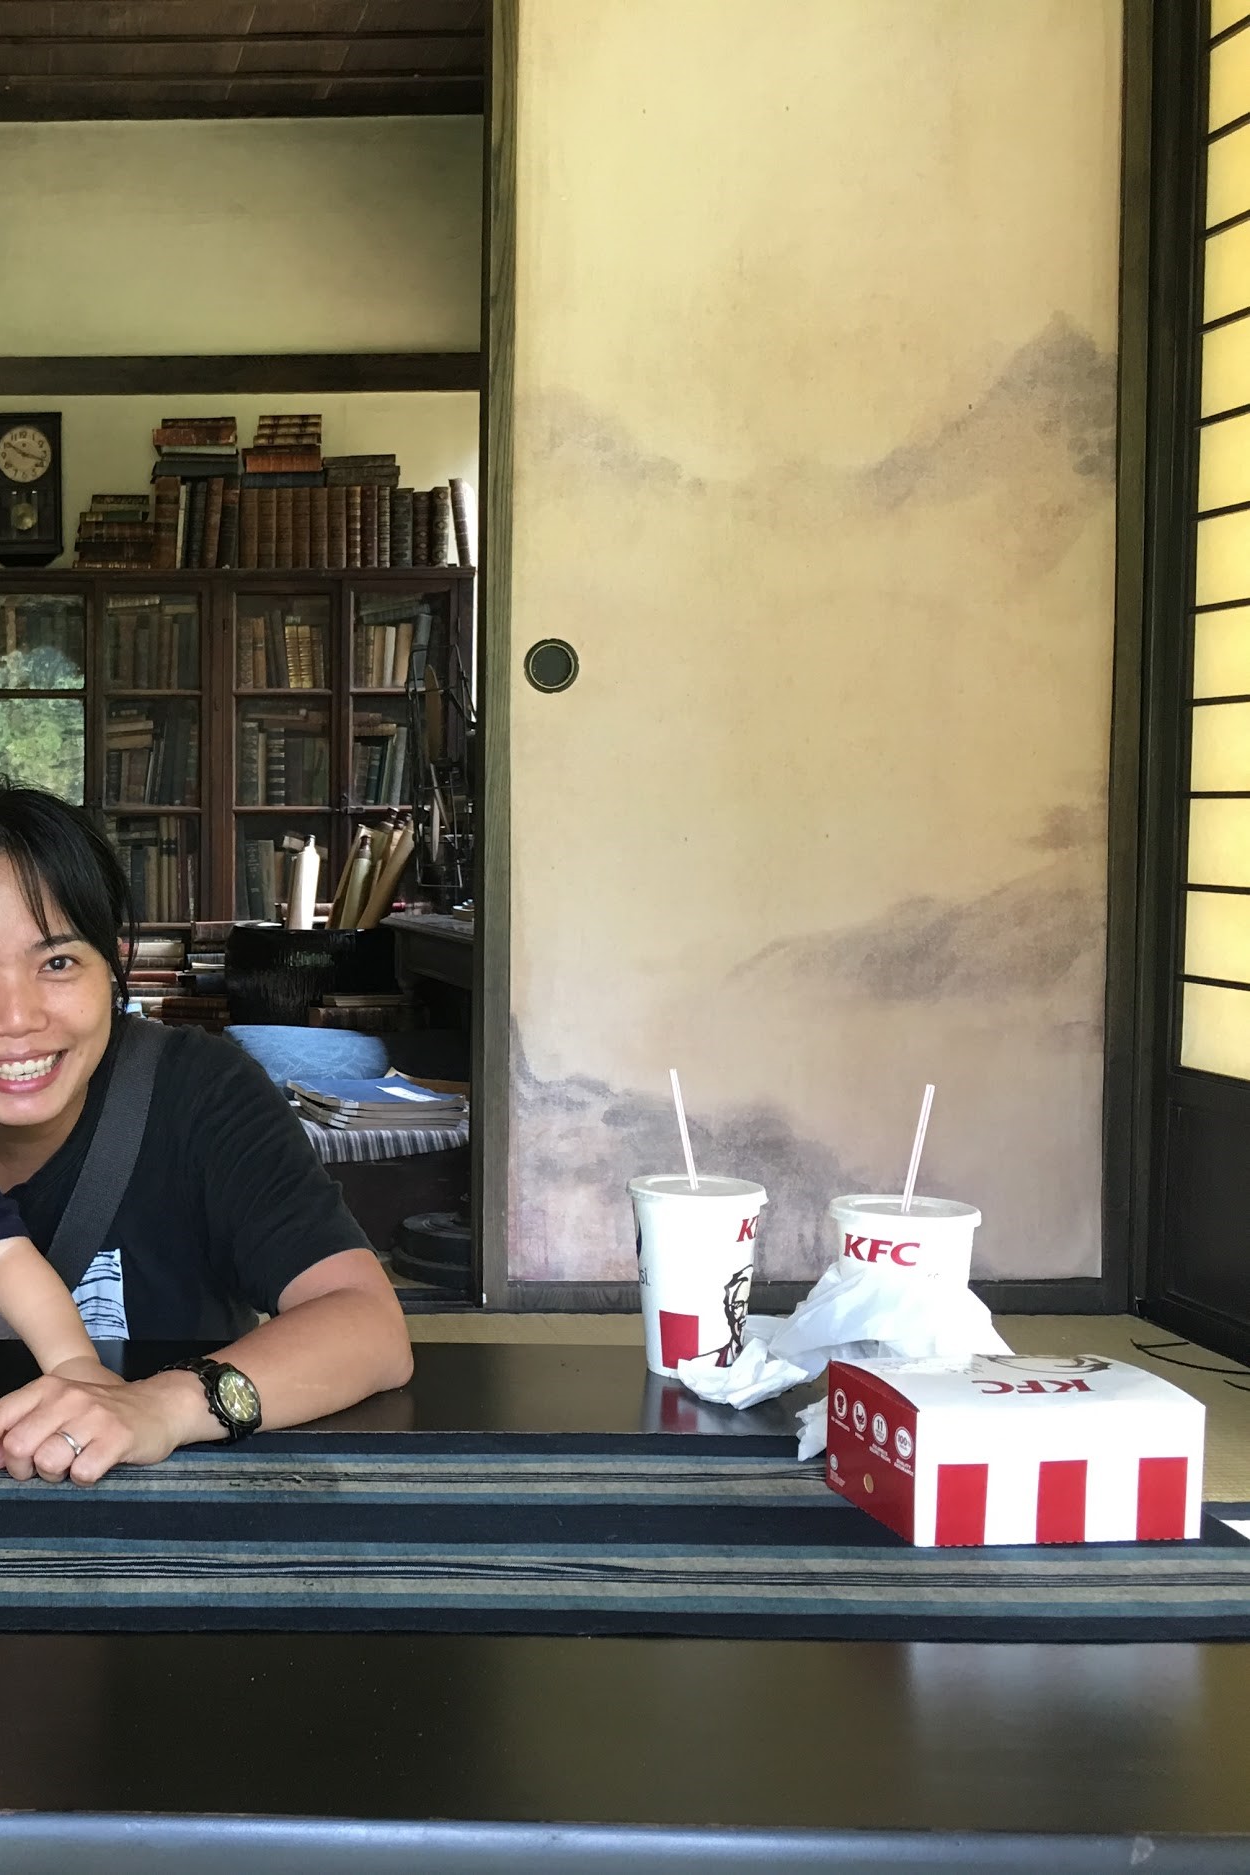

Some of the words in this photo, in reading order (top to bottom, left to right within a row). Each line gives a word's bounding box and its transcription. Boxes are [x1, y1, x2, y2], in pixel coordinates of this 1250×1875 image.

[19, 431, 27, 439] 12
[736, 1215, 759, 1242] K
[843, 1233, 920, 1267] KFC
[971, 1379, 1096, 1394] KFC
